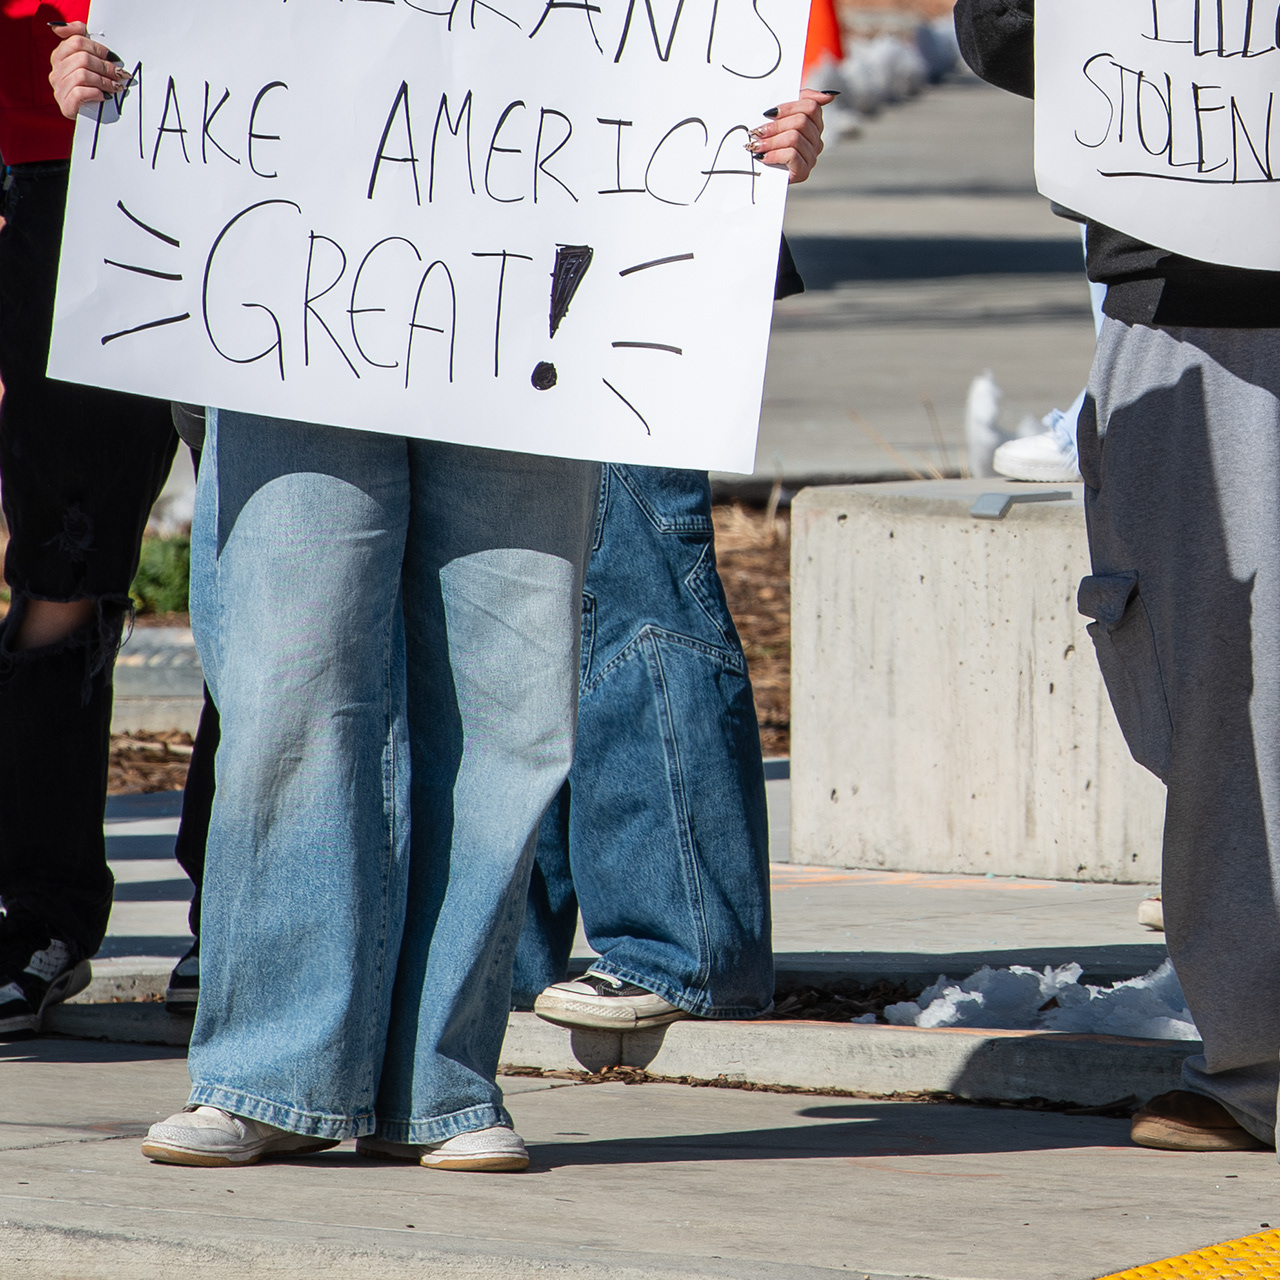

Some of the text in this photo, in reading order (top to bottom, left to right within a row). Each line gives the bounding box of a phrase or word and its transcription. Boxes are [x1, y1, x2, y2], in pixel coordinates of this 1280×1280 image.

[91, 60, 761, 206] MAKE AMERICA
[1074, 52, 1275, 182] STOLEN
[202, 199, 594, 392] GREAT!
